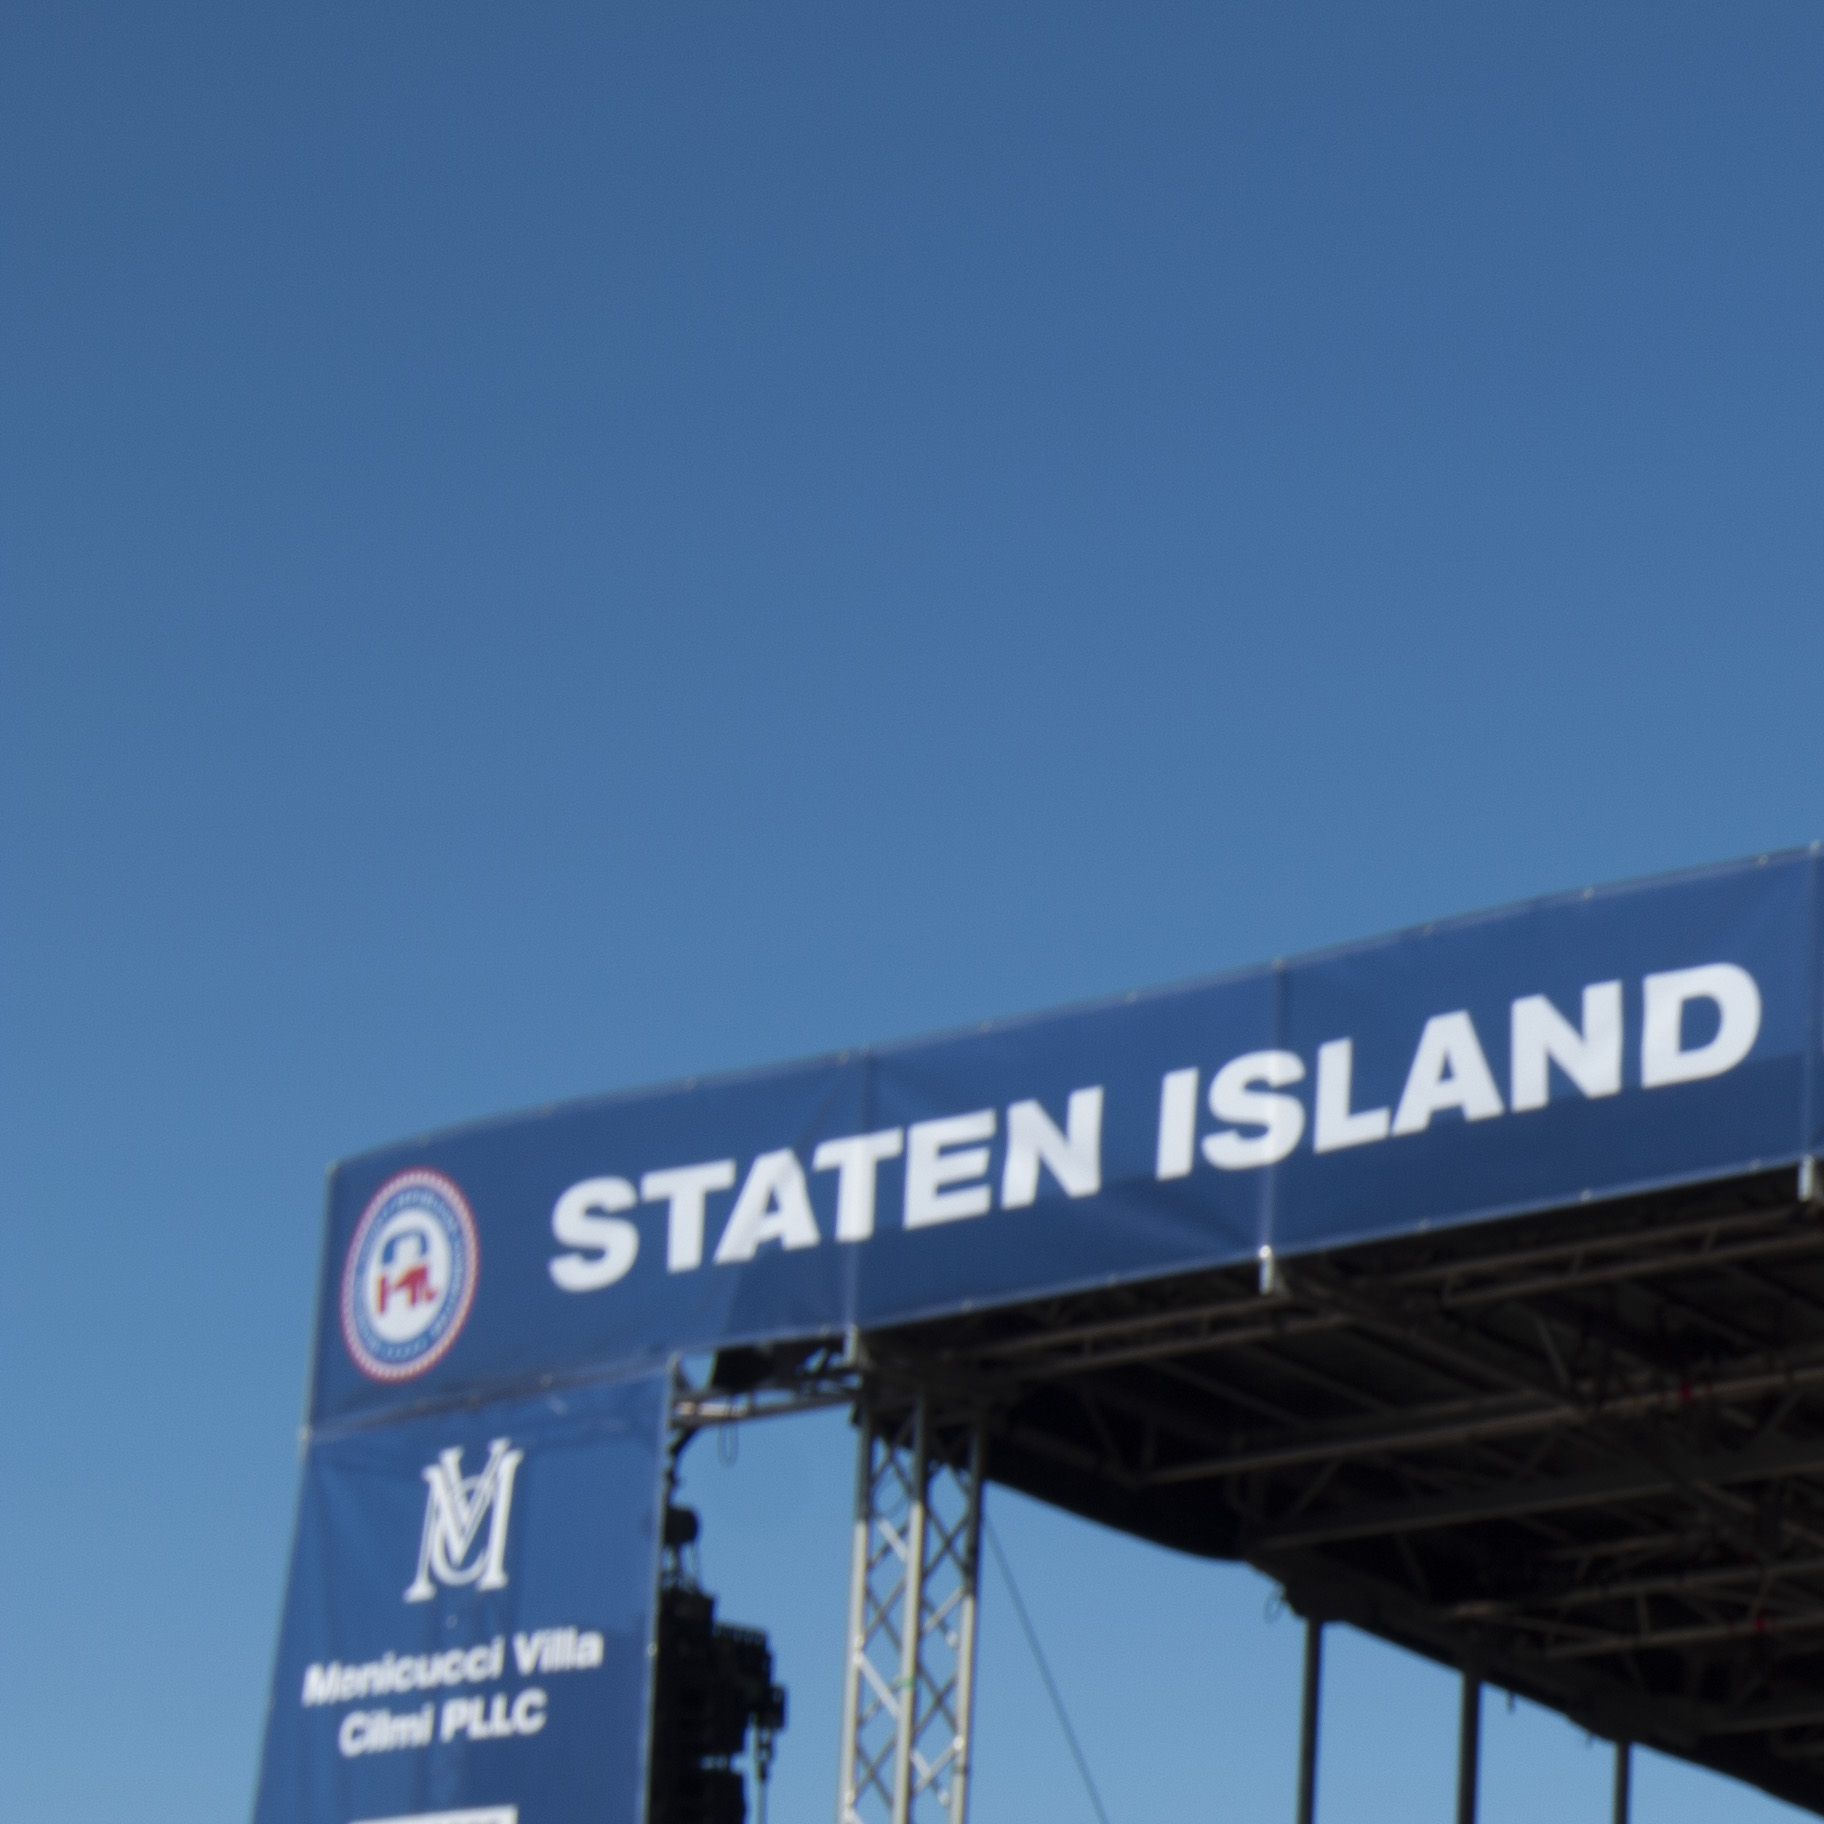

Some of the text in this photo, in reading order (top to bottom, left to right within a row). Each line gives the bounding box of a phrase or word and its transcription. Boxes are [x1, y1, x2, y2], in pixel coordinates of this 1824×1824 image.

[550, 1086, 1103, 1292] STATEN
[1157, 963, 1761, 1180] ISLAND
[301, 1626, 604, 1707] Menicucci Villa
[339, 1688, 547, 1757] Cilmi PLLC
